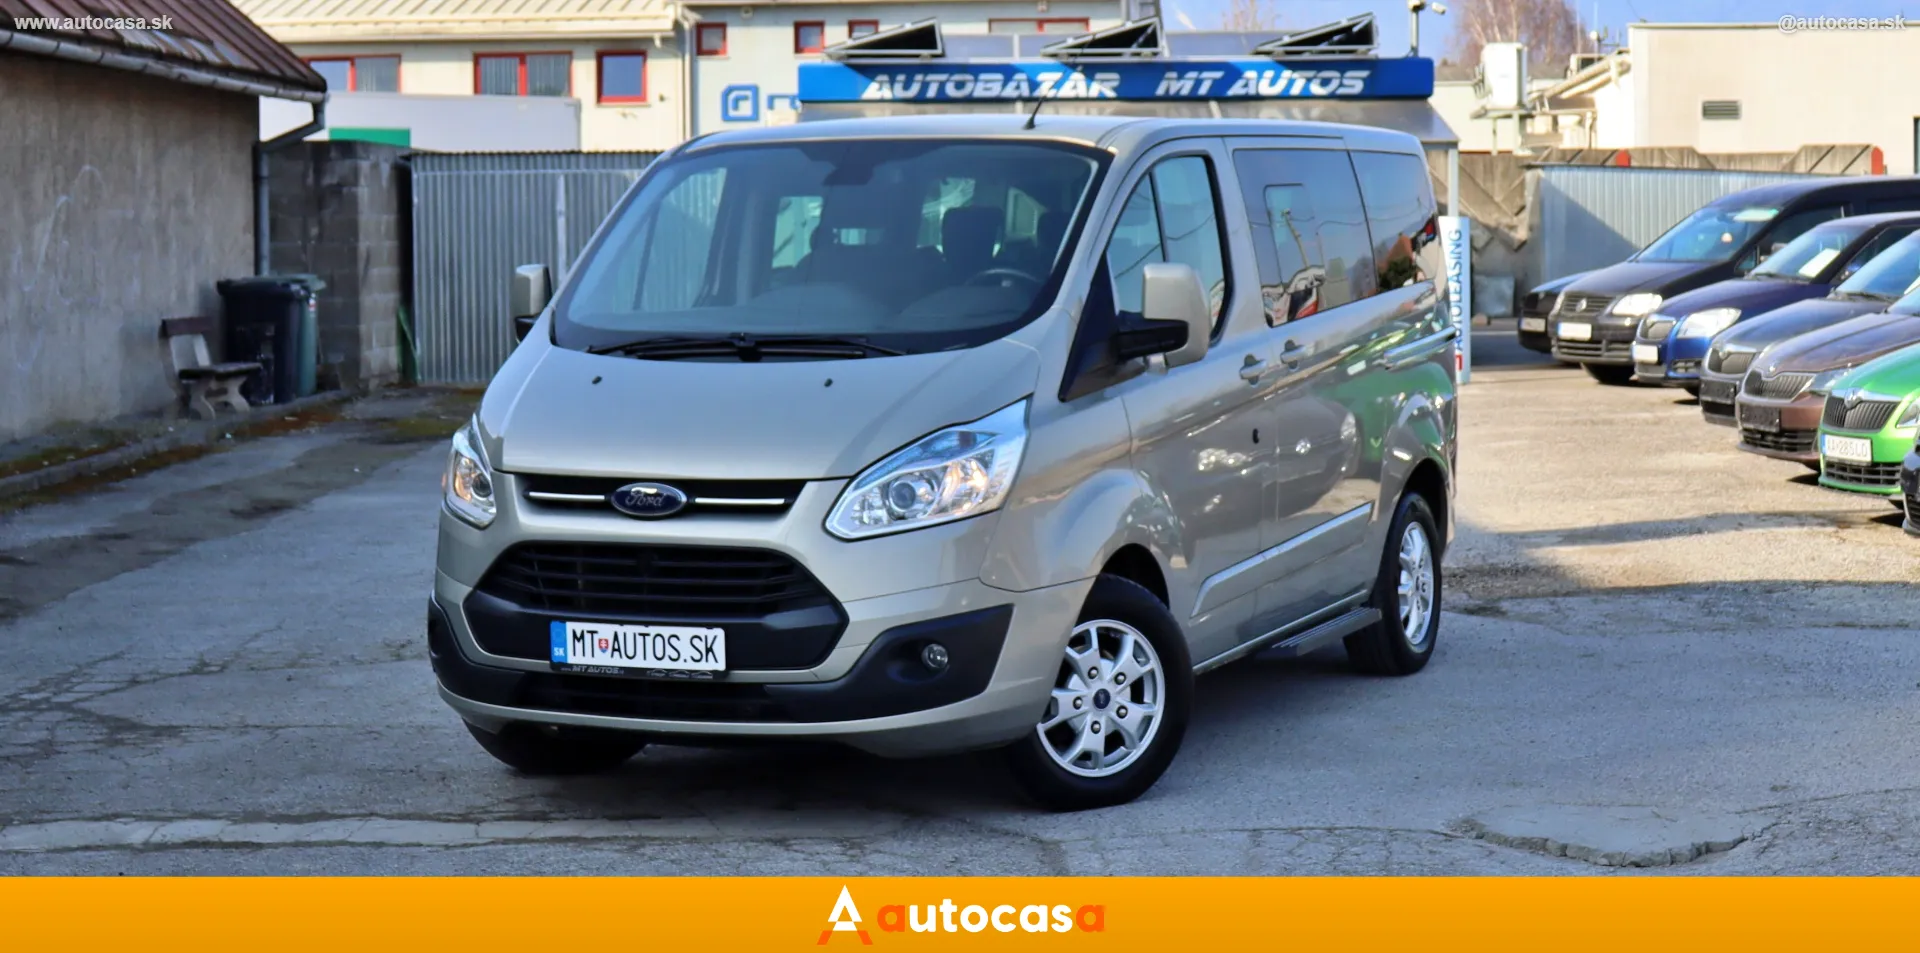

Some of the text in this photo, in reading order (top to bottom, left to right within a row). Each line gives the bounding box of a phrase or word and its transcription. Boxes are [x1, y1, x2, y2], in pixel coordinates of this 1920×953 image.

[860, 66, 1371, 99] AUTOBAZÁR MT AUTOS
[625, 487, 664, 506] Ford
[554, 647, 565, 656] SK
[572, 629, 719, 663] MT AUTOS.SK
